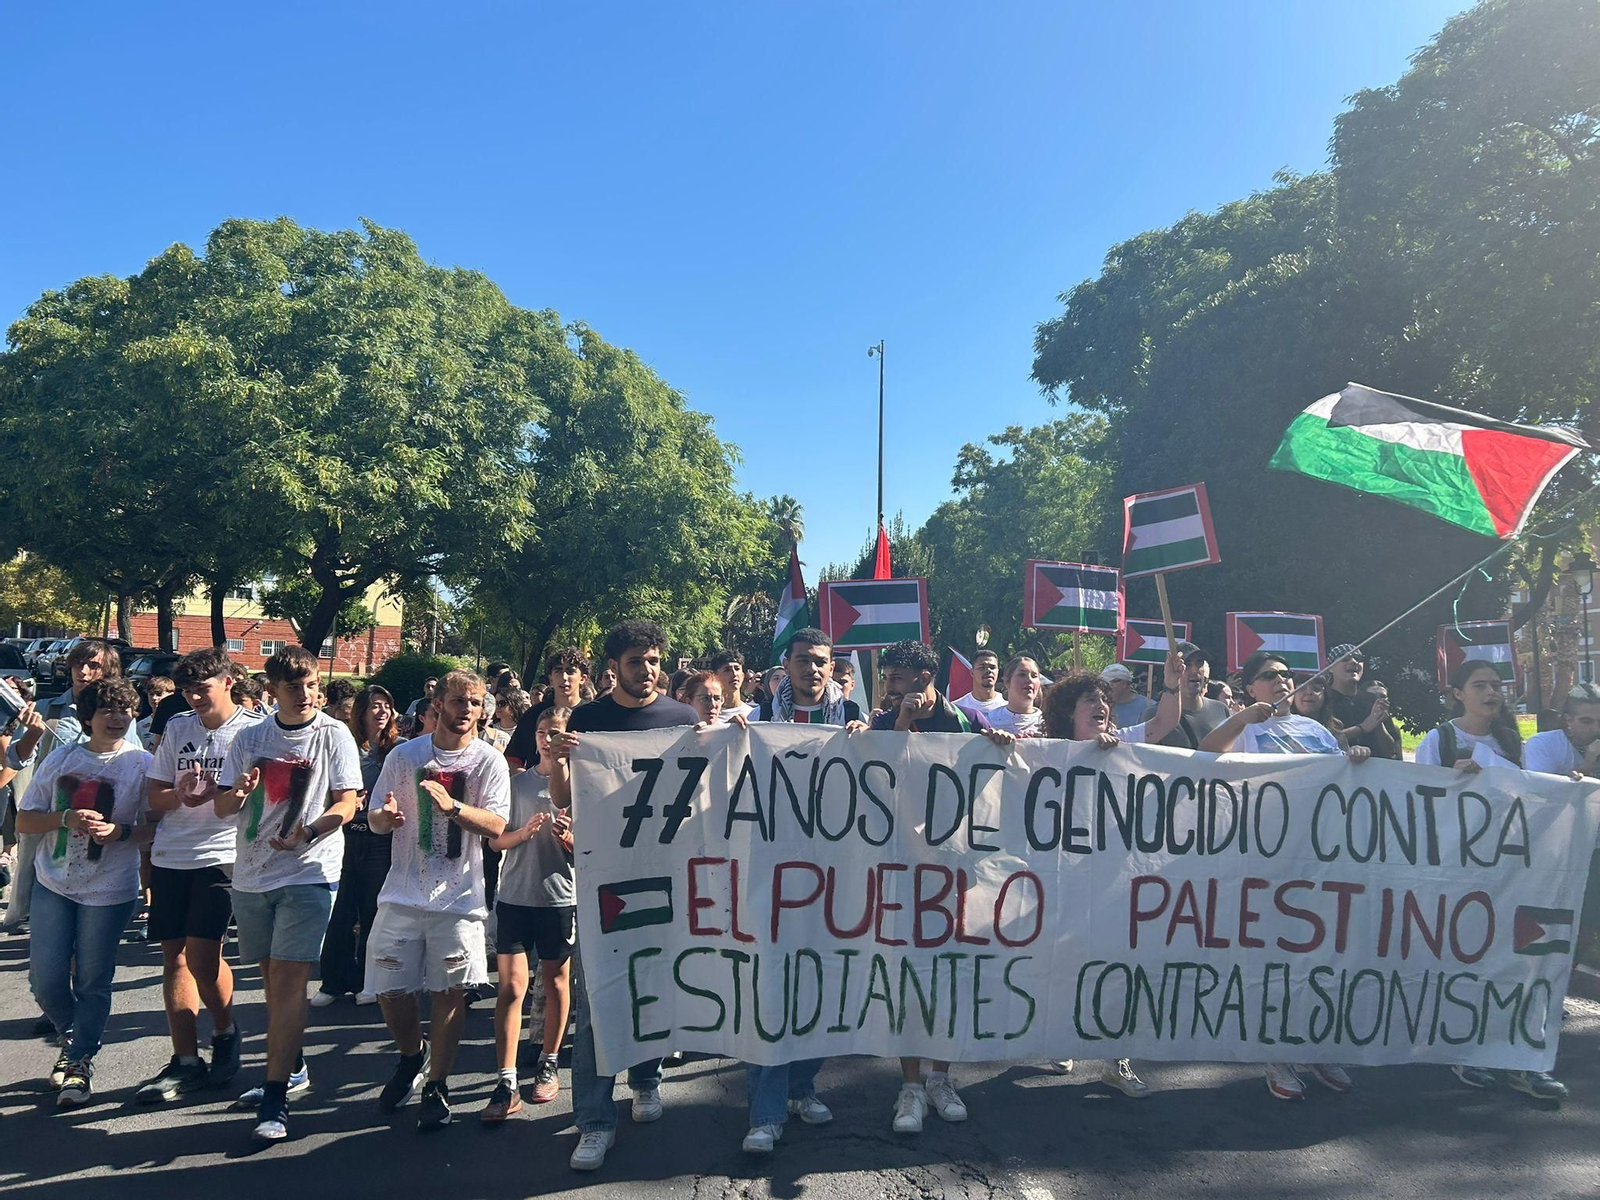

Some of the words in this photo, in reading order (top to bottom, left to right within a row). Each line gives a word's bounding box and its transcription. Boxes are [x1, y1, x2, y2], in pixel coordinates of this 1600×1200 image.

[619, 757, 709, 848] 77
[723, 750, 896, 847] AÑOS
[924, 763, 1006, 852] DE
[1024, 765, 1290, 859] GENOCIDIO
[1311, 783, 1531, 868] CONTRA
[686, 856, 757, 943] EL
[770, 861, 1045, 949] PUEBLO
[1128, 875, 1496, 965] PALESTINO
[628, 947, 1036, 1044] ESTUDIANTES
[1073, 960, 1247, 1042] CONTRA
[1258, 962, 1306, 1046] EL
[1307, 964, 1553, 1050] SIONISMO
